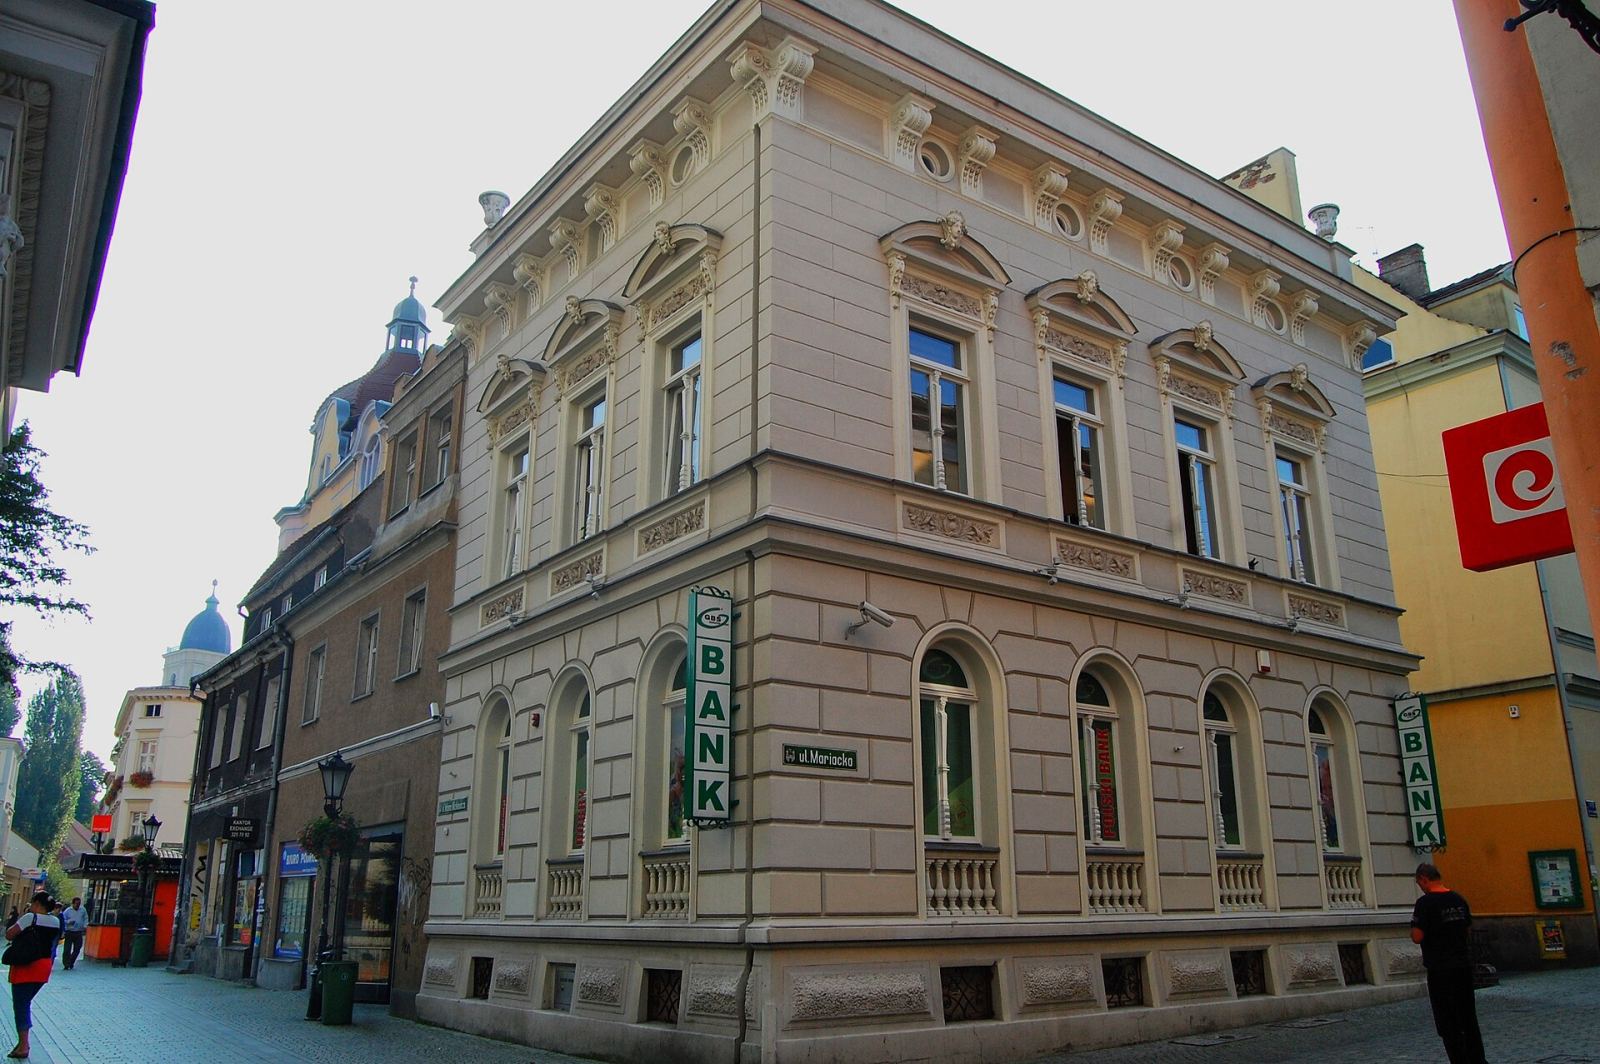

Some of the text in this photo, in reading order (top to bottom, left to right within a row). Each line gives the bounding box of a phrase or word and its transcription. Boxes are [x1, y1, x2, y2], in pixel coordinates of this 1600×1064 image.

[697, 644, 726, 812] BANK
[1097, 728, 1117, 839] POLSKI BANK
[1404, 731, 1438, 843] BANK
